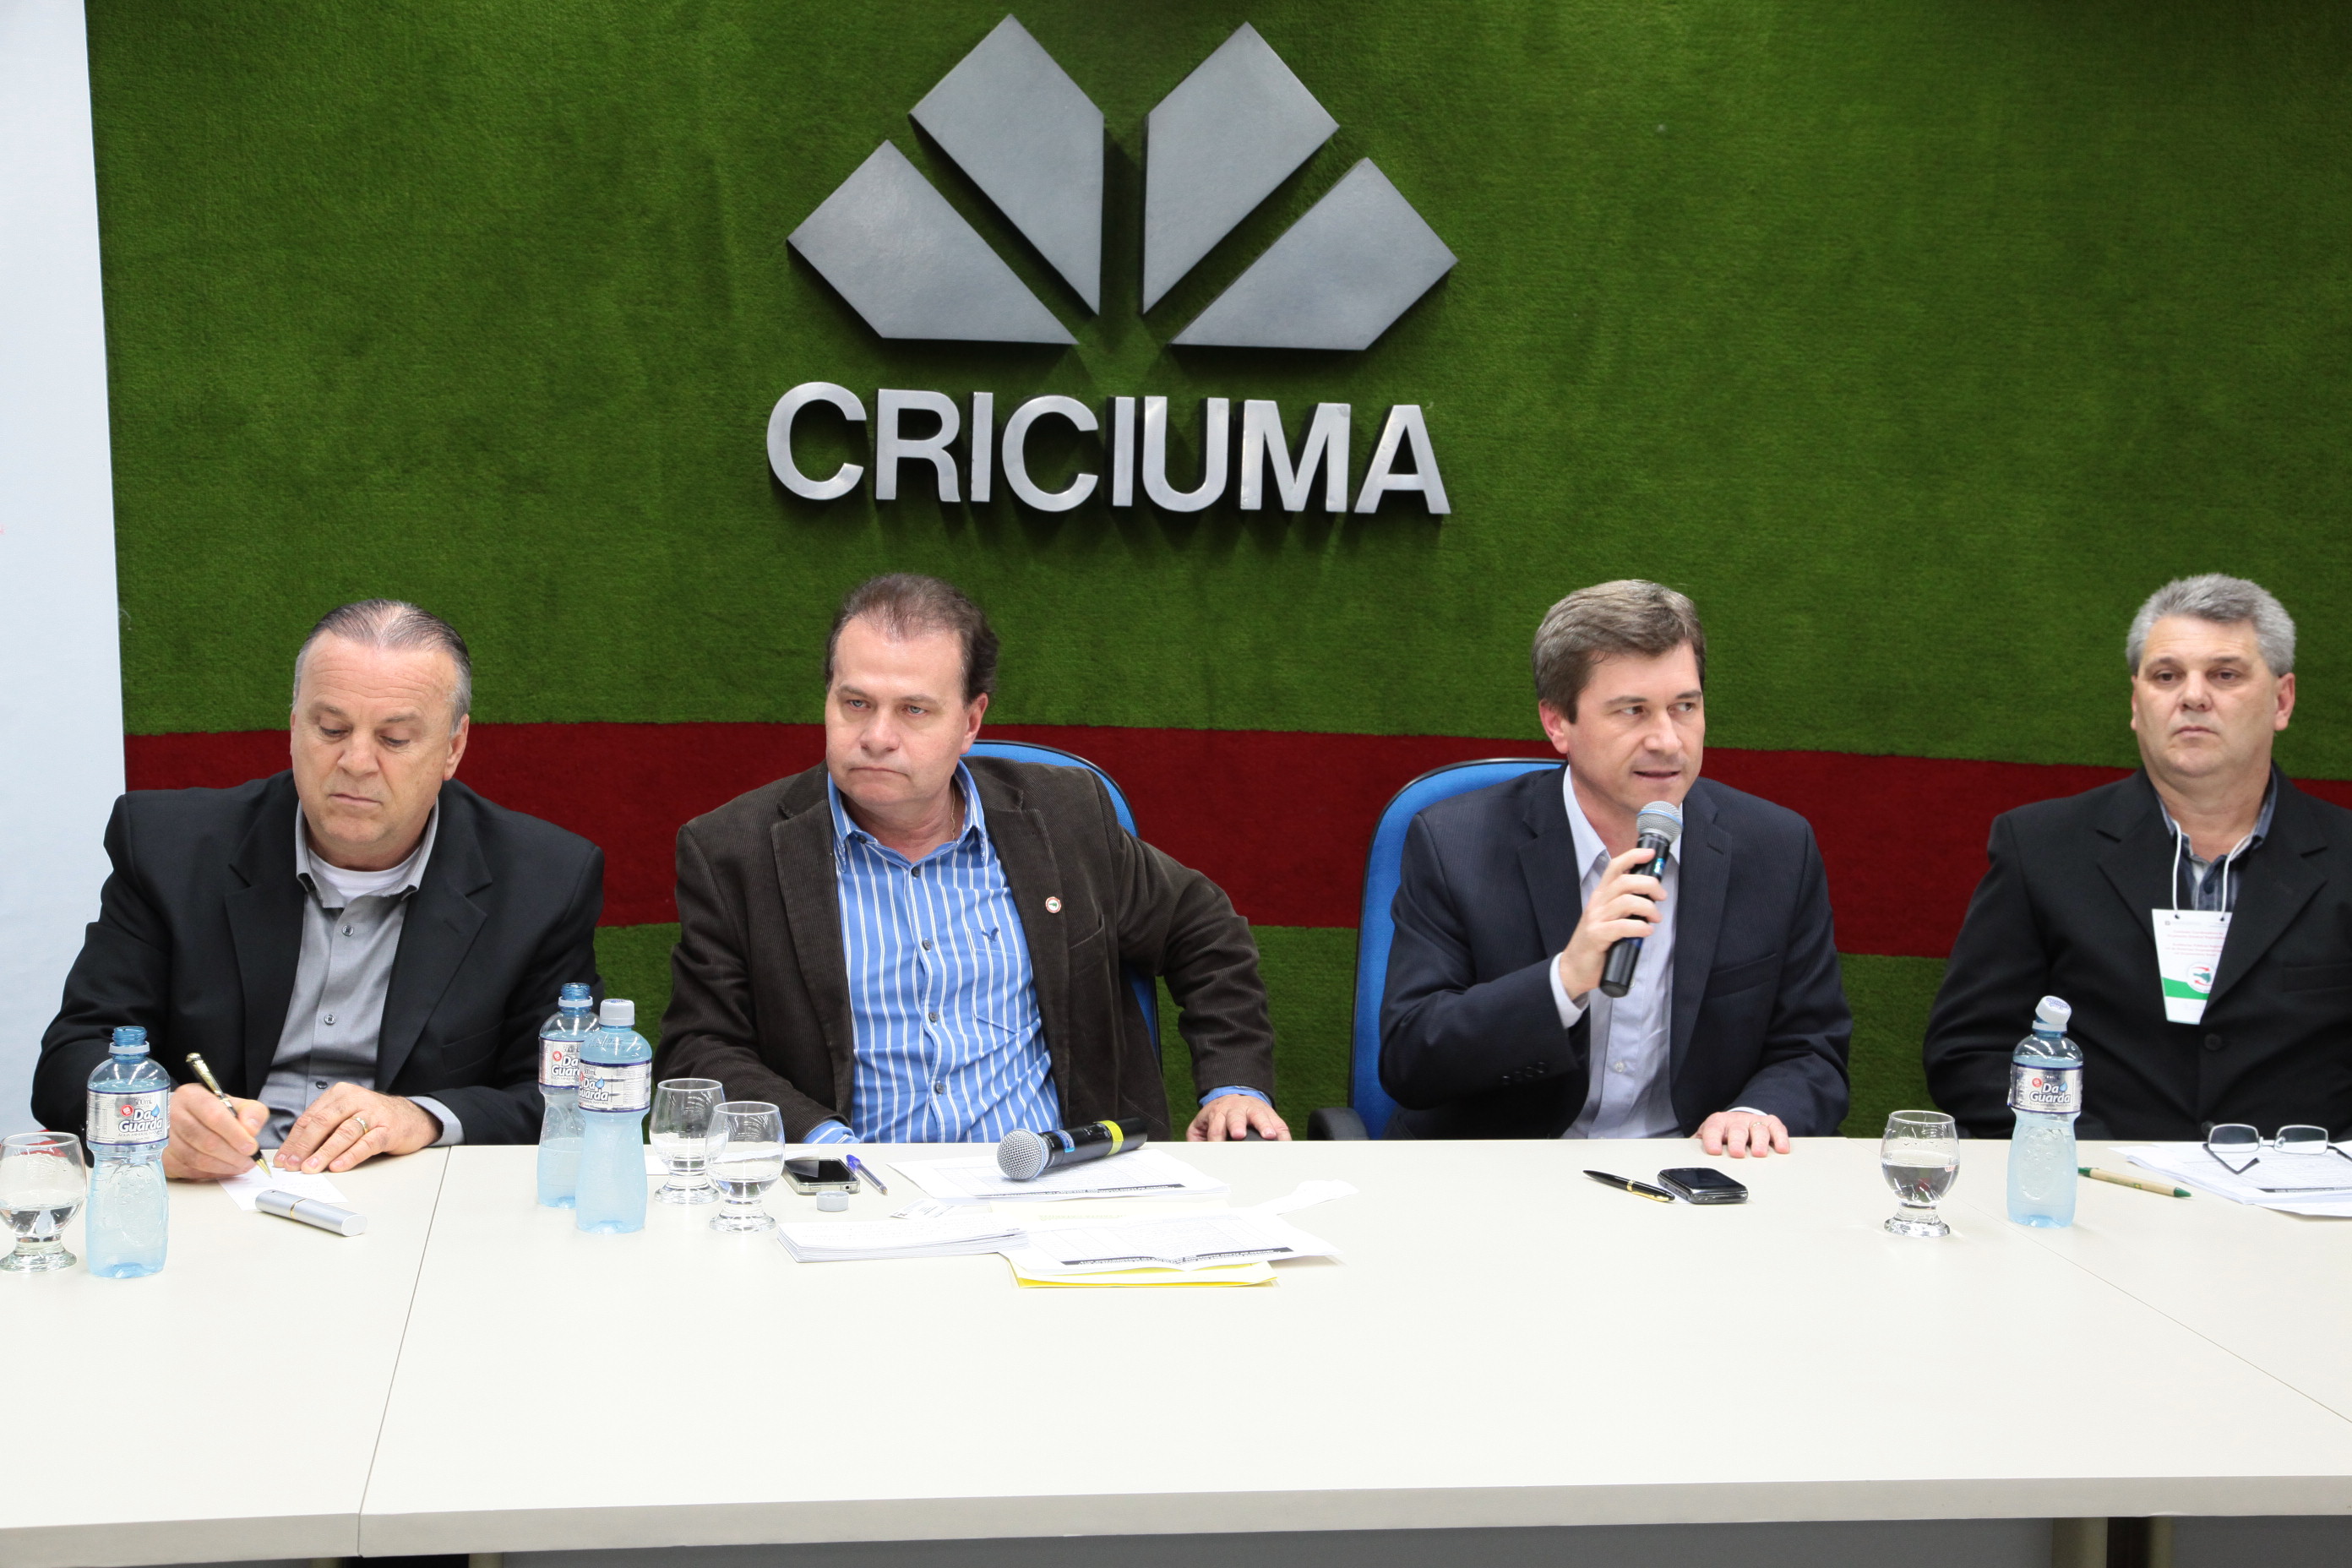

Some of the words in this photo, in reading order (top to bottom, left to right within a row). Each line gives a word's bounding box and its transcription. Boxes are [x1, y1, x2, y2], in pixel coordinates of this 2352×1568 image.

[766, 380, 1451, 515] CRICIUMA
[562, 1055, 580, 1067] Da
[551, 1064, 580, 1076] Guar
[583, 1077, 596, 1090] Da
[2041, 1082, 2060, 1094] Da
[2029, 1091, 2071, 1103] Guarda
[133, 1108, 152, 1122] Da
[118, 1118, 163, 1133] Guarda
